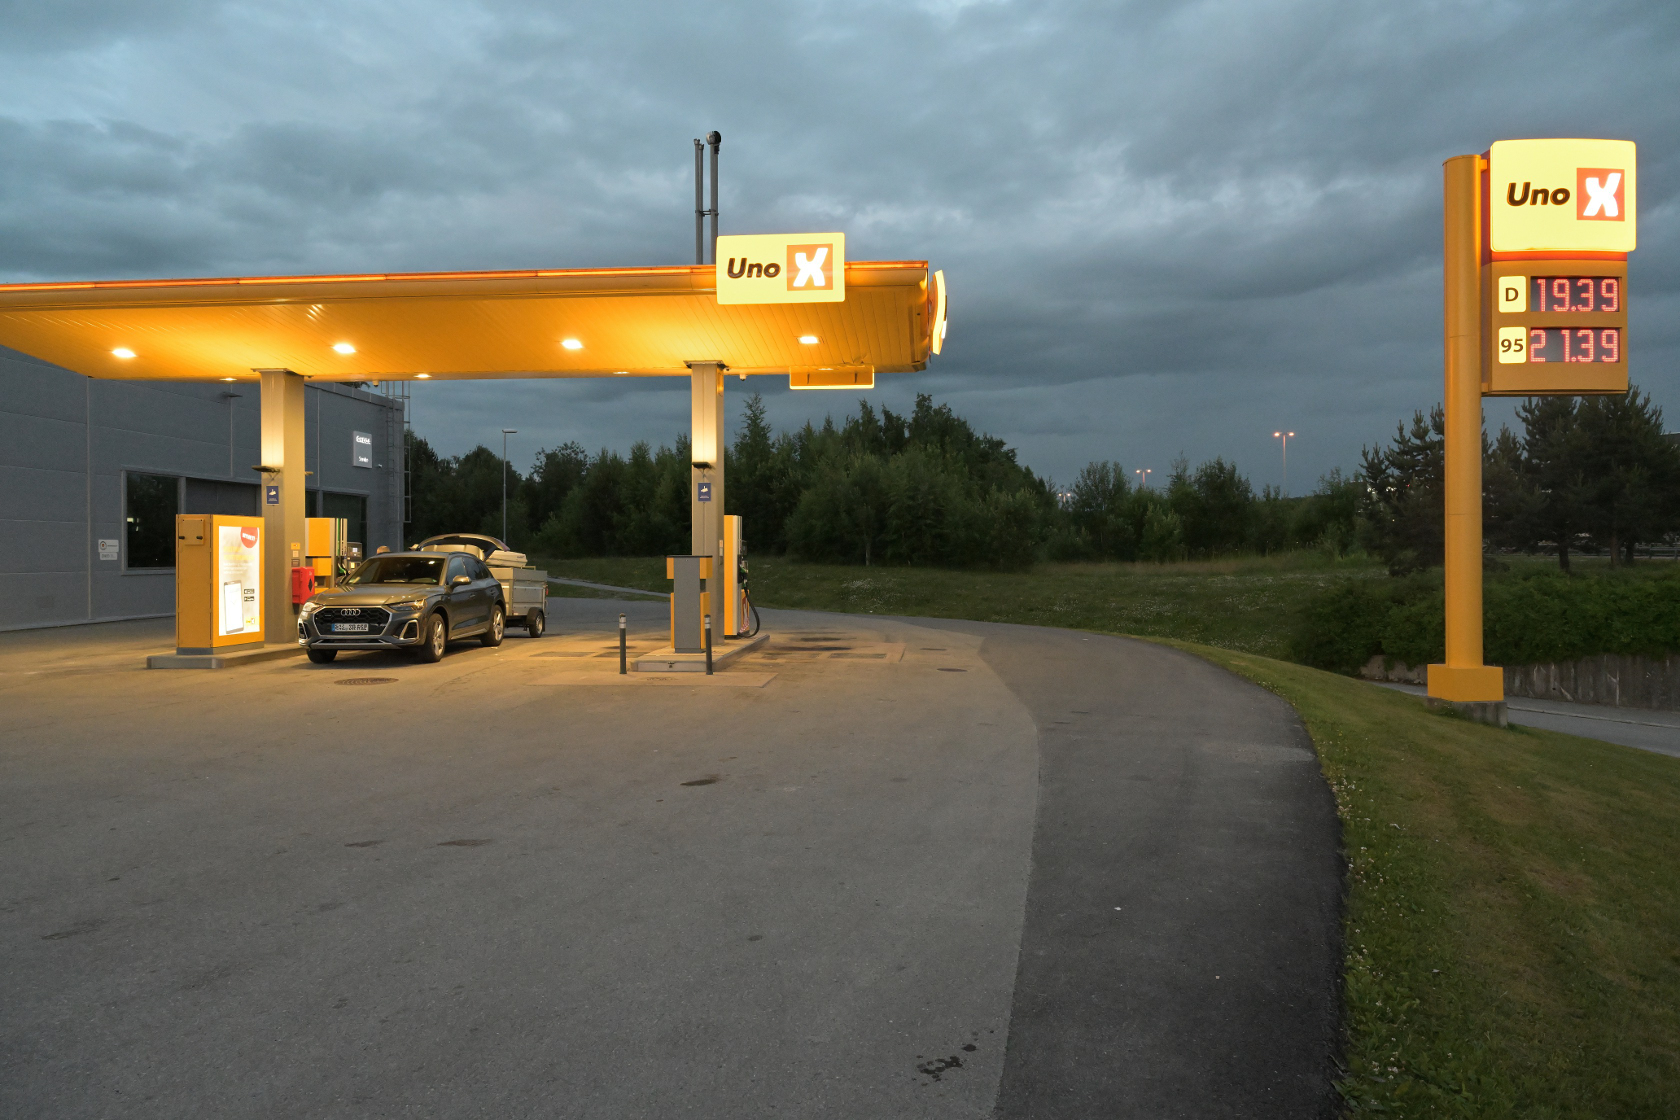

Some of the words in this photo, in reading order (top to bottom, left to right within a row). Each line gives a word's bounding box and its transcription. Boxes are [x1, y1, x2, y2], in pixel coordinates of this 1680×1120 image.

[1507, 181, 1570, 207] Uno
[1583, 172, 1622, 218] X
[727, 257, 781, 279] Uno
[793, 247, 829, 287] X
[1505, 287, 1519, 302] D
[1537, 278, 1618, 312] 19.39
[1501, 338, 1524, 353] 95
[1530, 329, 1618, 363] 21.39
